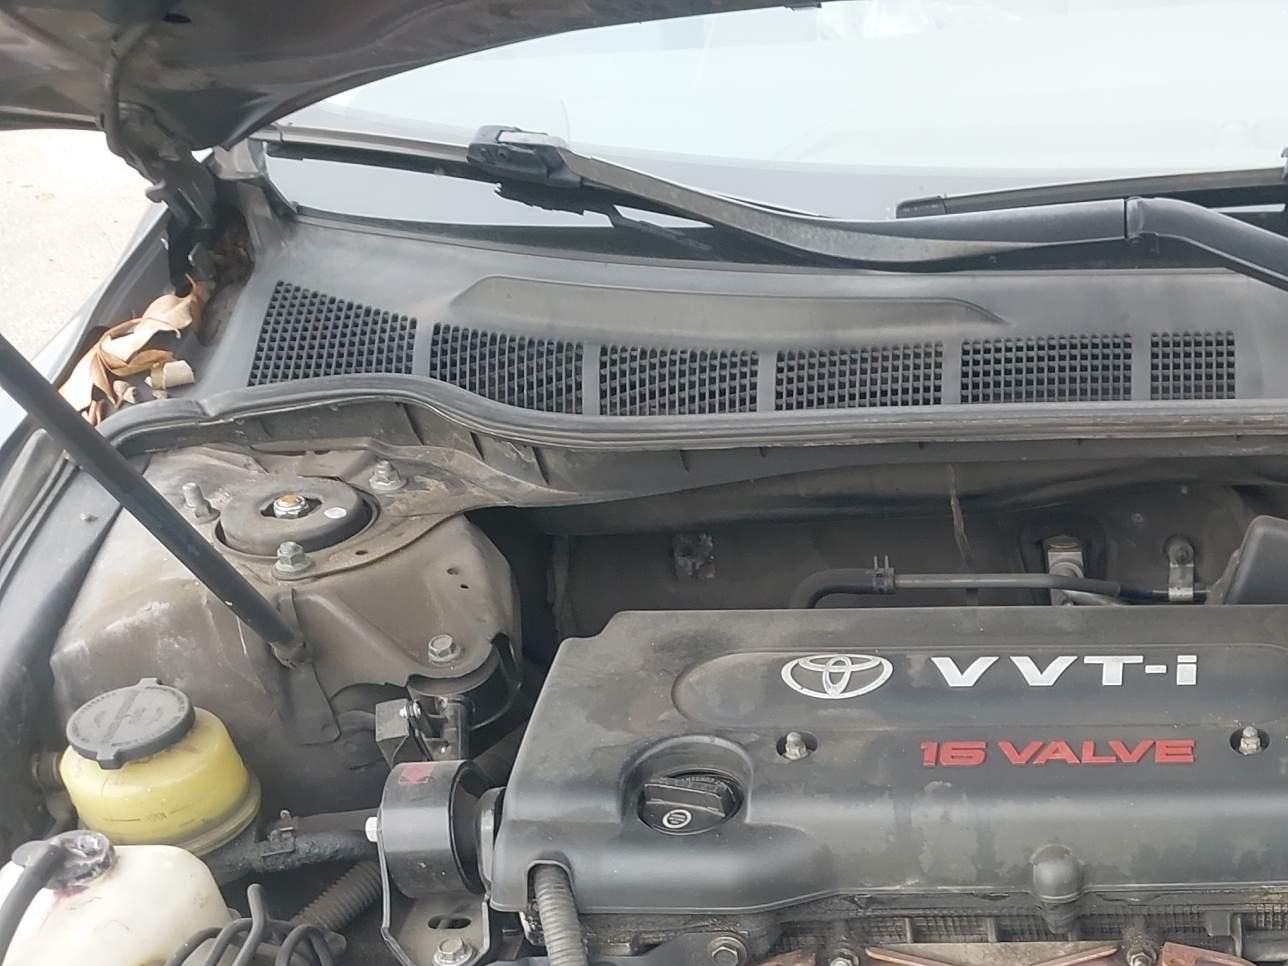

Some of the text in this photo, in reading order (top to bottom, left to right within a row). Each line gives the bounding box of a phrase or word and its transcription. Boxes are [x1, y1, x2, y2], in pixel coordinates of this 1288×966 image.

[931, 655, 1197, 687] VVT-i
[920, 739, 1197, 767] 16 VALVE
